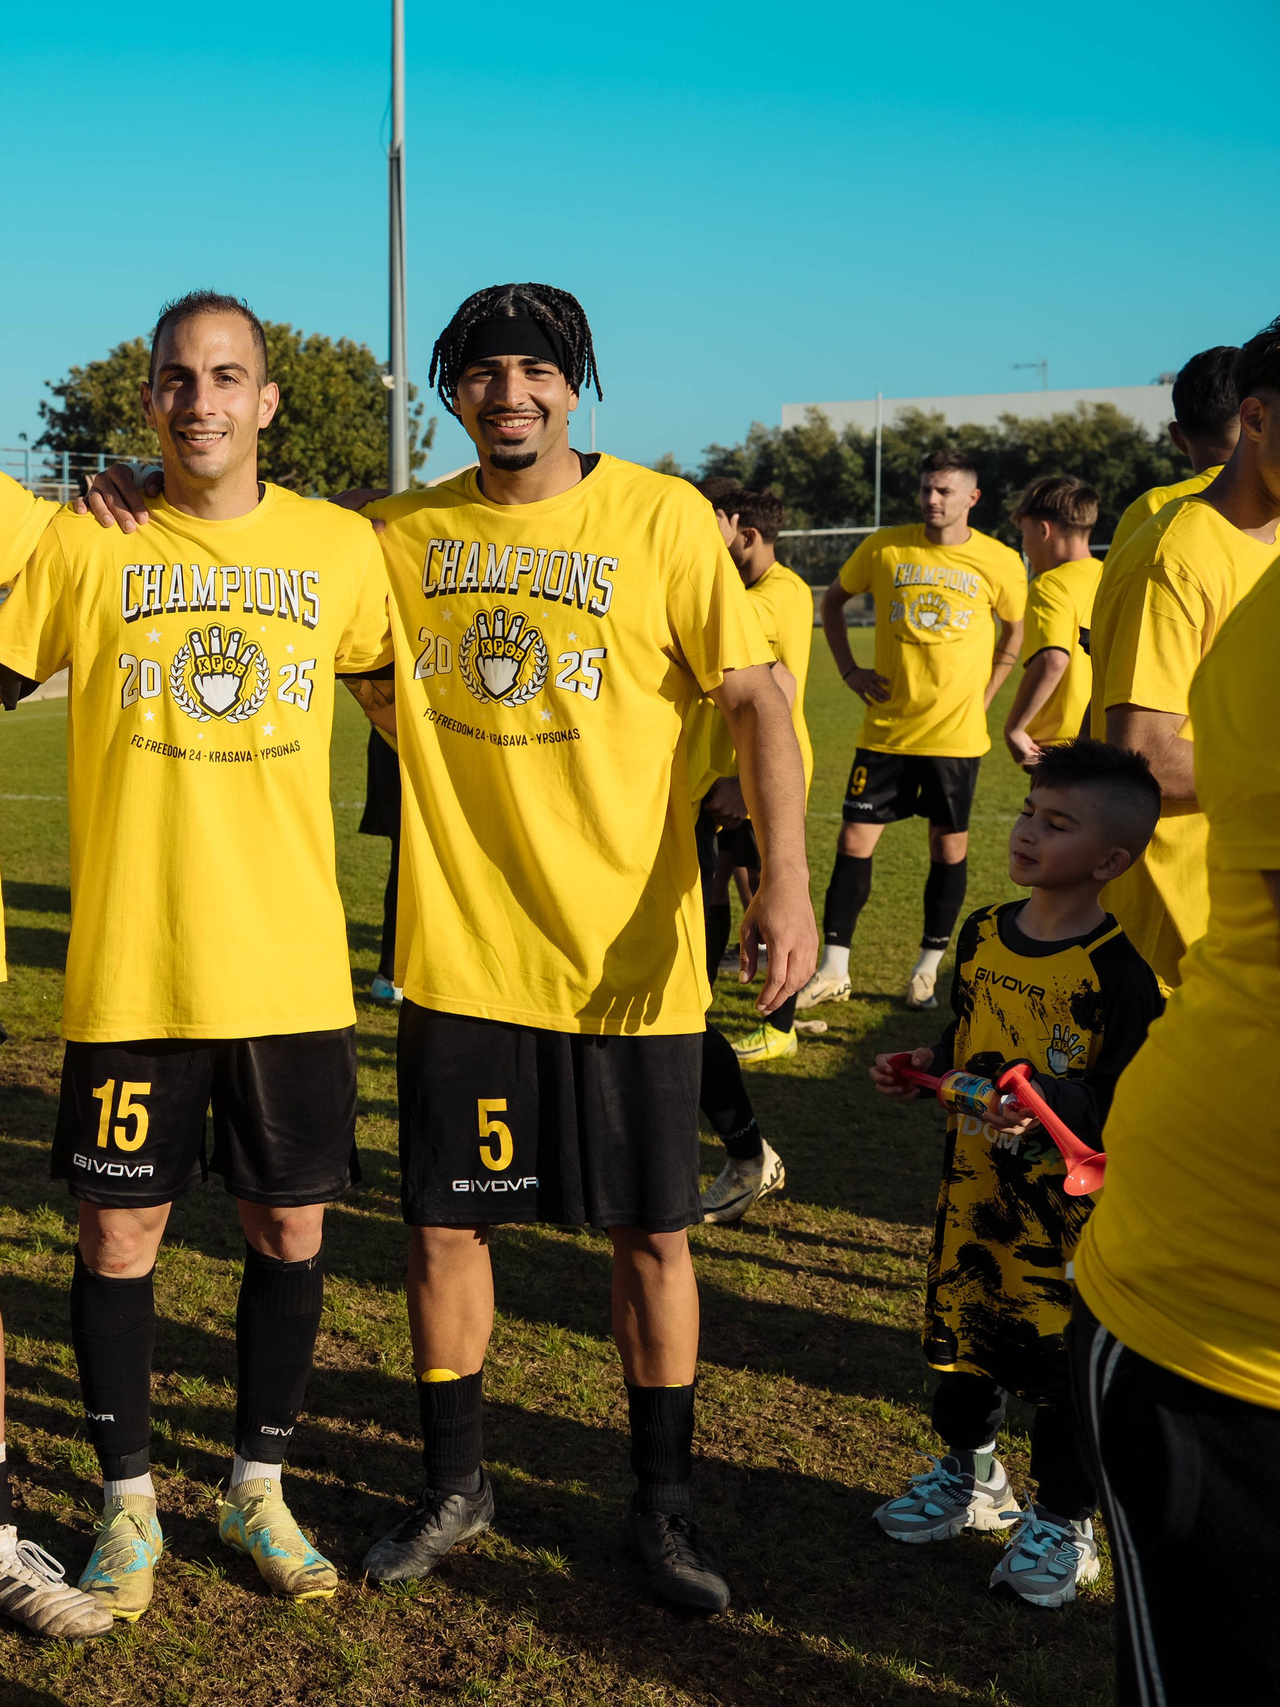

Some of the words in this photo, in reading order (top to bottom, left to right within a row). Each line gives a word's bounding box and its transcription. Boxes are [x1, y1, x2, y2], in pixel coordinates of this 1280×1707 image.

[120, 562, 320, 631] CHAMPIONS
[421, 538, 619, 618] CHAMPIONS
[894, 563, 980, 599] CHAMPIONS
[953, 609, 974, 629] 25
[119, 652, 163, 709] 20
[277, 658, 317, 712] 25
[412, 627, 453, 681] 20
[554, 647, 608, 701] 25
[423, 707, 437, 721] FC
[435, 713, 474, 738] FREEDOM
[475, 728, 486, 741] 24
[489, 732, 528, 747] KRASAVA
[535, 727, 581, 744] YPSONAS
[130, 734, 145, 749] FC
[144, 739, 187, 760] FREEDOM
[188, 749, 202, 762] 24
[208, 750, 253, 763] KRASAVA
[260, 740, 301, 760] YPSONAS
[851, 765, 868, 796] 9
[974, 966, 1046, 1001] GIVOVA
[92, 1078, 152, 1151] 15
[477, 1098, 514, 1171] 5
[957, 1113, 1021, 1156] DOM
[72, 1152, 155, 1178] GIVOVA
[451, 1176, 540, 1193] GIVOVA
